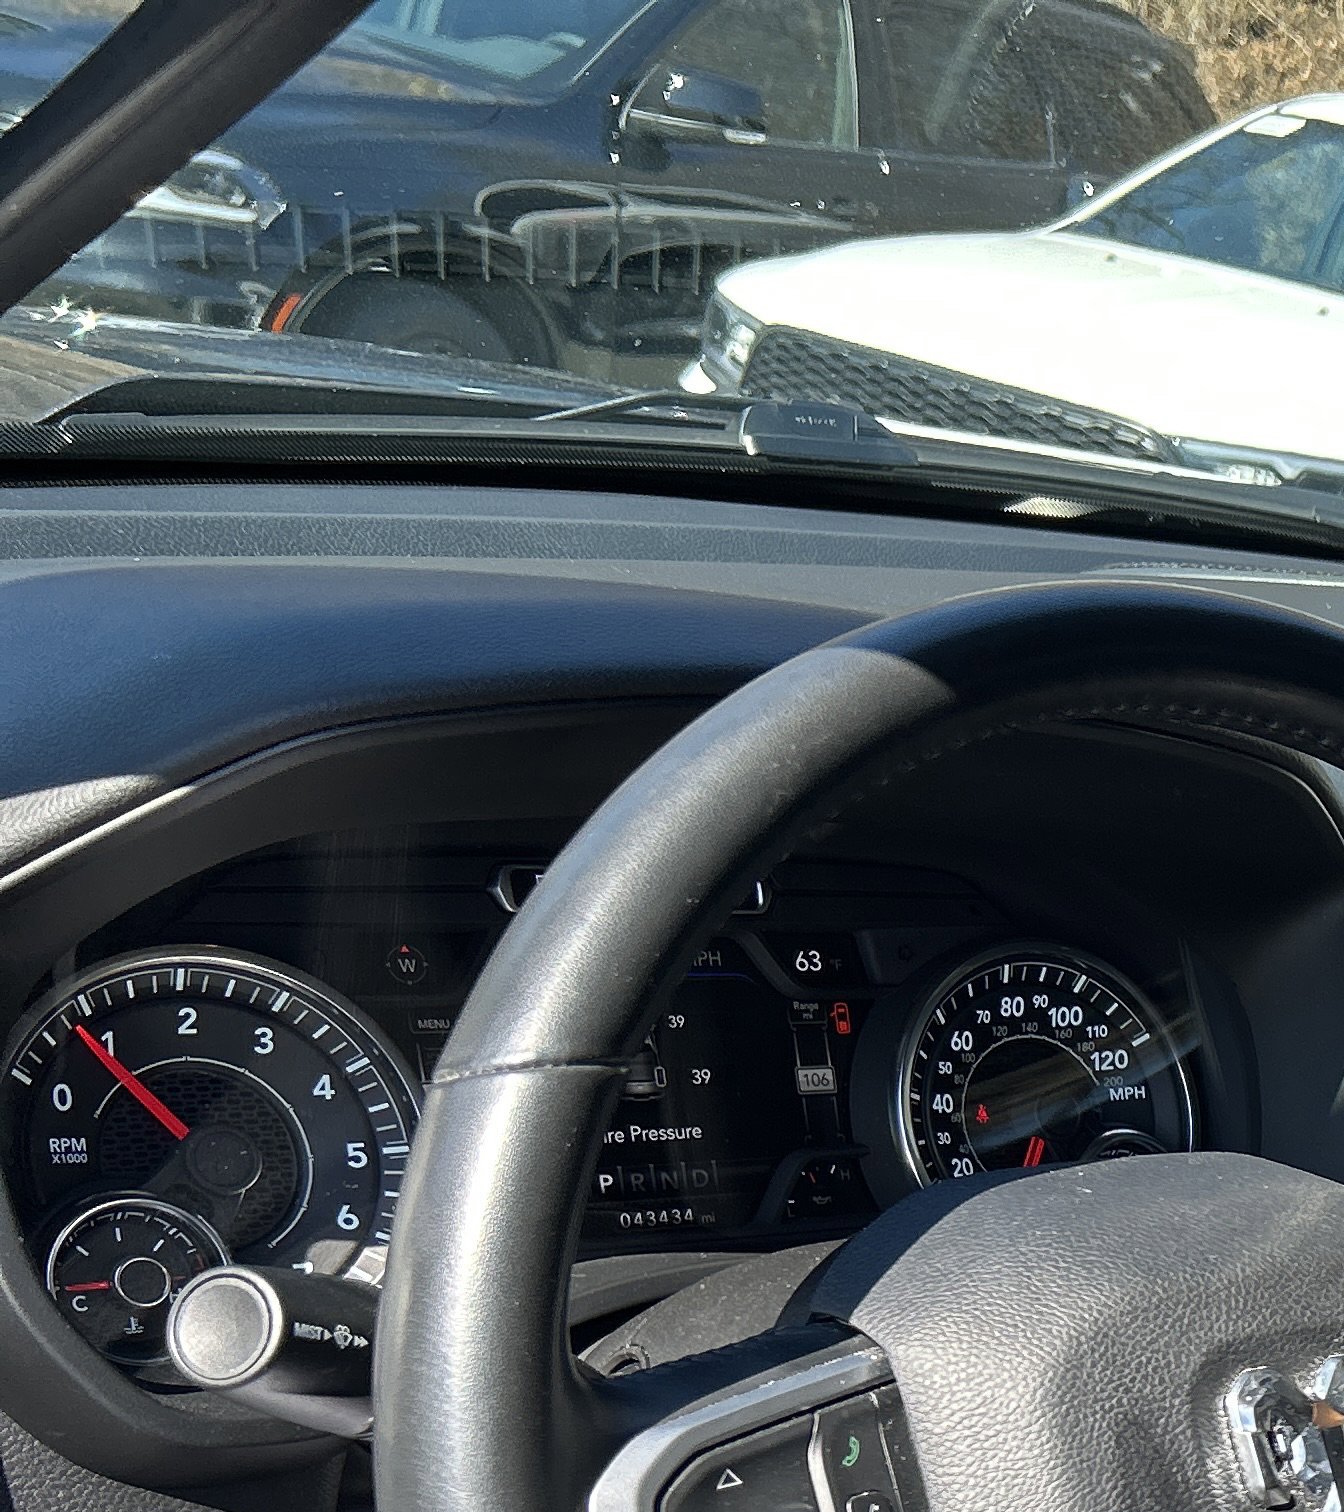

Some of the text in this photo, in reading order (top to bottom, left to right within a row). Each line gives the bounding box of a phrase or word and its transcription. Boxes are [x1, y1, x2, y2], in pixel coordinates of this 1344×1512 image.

[398, 958, 416, 973] W
[795, 950, 822, 972] 63
[1000, 997, 1025, 1017] 80
[1033, 995, 1049, 1008] 90
[177, 1007, 198, 1035] 2
[668, 1015, 685, 1029] 39
[976, 1010, 991, 1024] 70
[1048, 1006, 1083, 1028] 100
[254, 1027, 275, 1055] 3
[951, 1031, 973, 1051] 60
[1055, 1028, 1073, 1039] 160
[1086, 1025, 1108, 1039] 110
[1077, 1041, 1095, 1052] 180
[938, 1062, 952, 1075] 50
[1090, 1050, 1129, 1071] 120
[691, 1068, 711, 1085] 39
[803, 1072, 830, 1087] 106
[52, 1083, 73, 1112] 0
[312, 1074, 336, 1101] 4
[1109, 1086, 1146, 1101] MPH
[932, 1094, 954, 1114] 40
[603, 1125, 702, 1145] ire Pressure
[937, 1132, 951, 1145] 30
[50, 1138, 87, 1153] RPM
[346, 1142, 368, 1169] 5
[52, 1153, 88, 1164] X1000
[952, 1157, 973, 1178] 20
[599, 1169, 709, 1194] P R N D
[337, 1205, 360, 1231] 6
[620, 1208, 694, 1229] 043434
[72, 1295, 88, 1312] C
